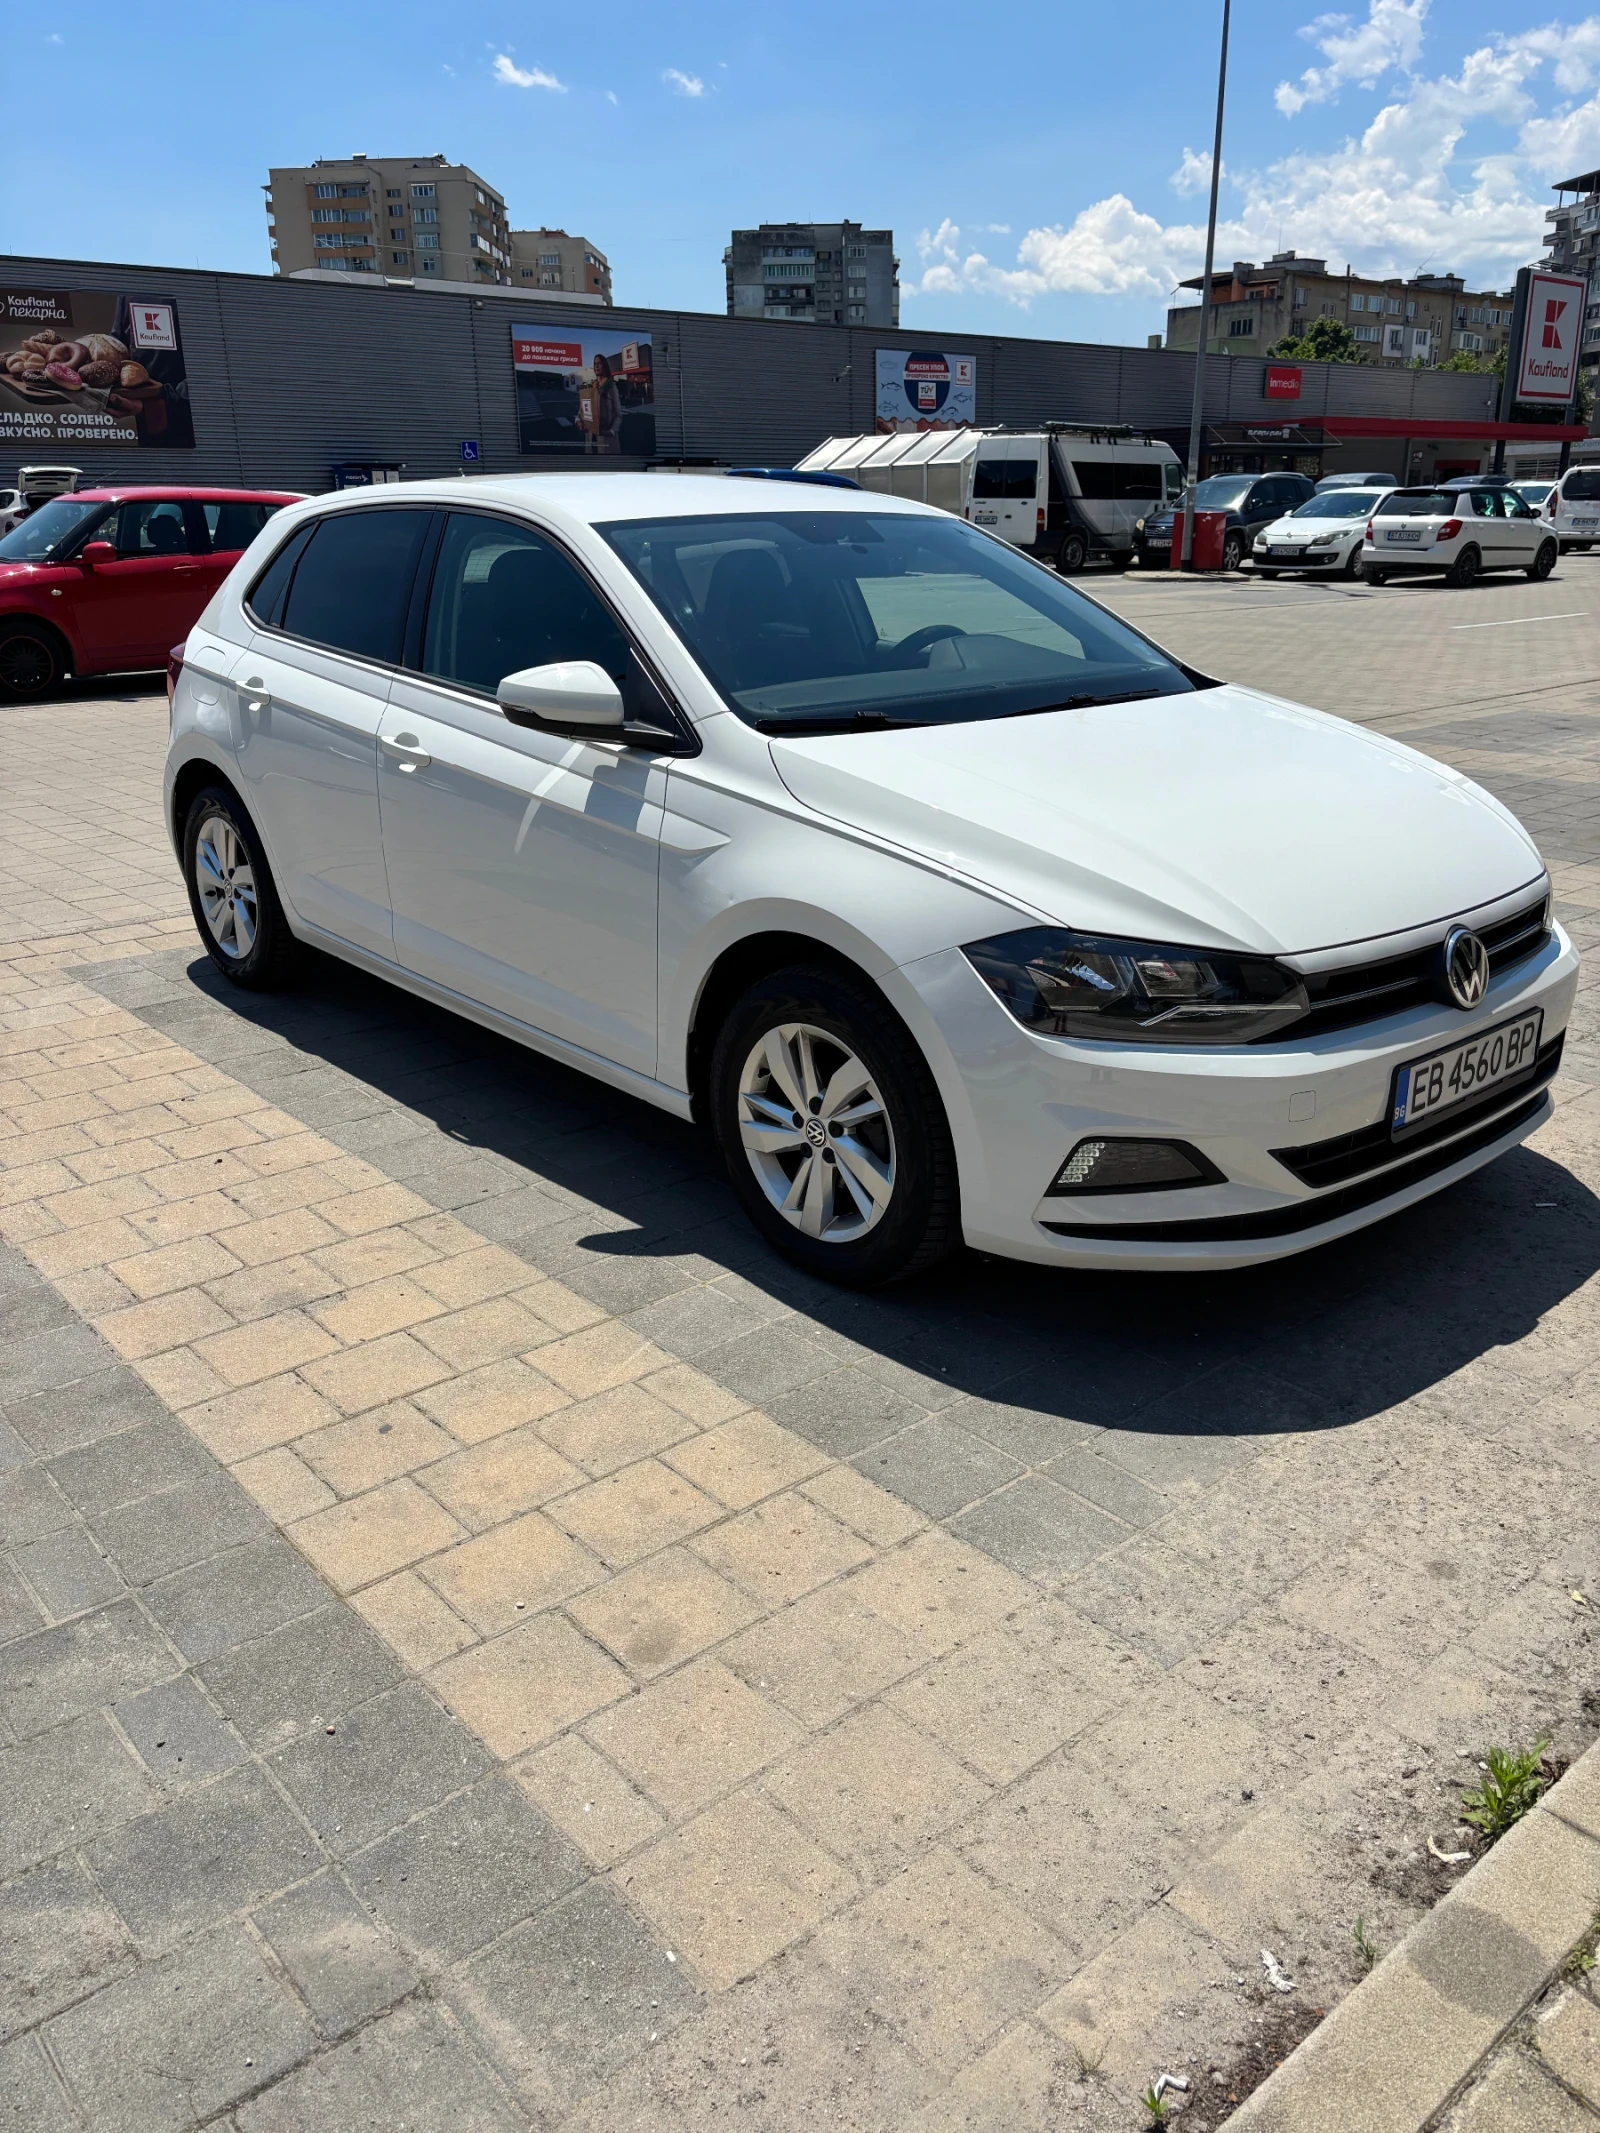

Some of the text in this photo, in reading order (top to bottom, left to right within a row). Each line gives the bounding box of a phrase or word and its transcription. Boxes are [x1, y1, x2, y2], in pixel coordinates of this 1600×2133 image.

[7, 295, 56, 308] Kaufland
[9, 306, 67, 320] пекарна
[139, 333, 170, 341] Kaufland
[1528, 358, 1569, 379] Kaufland
[1269, 377, 1300, 389] inmedio
[0, 412, 117, 426] ЛАДКО. СОЛЕНО.
[57, 427, 139, 440] ПРОВЕРЕНО.
[1411, 1021, 1535, 1114] EB 4560 BP
[1394, 1105, 1406, 1121] BG
